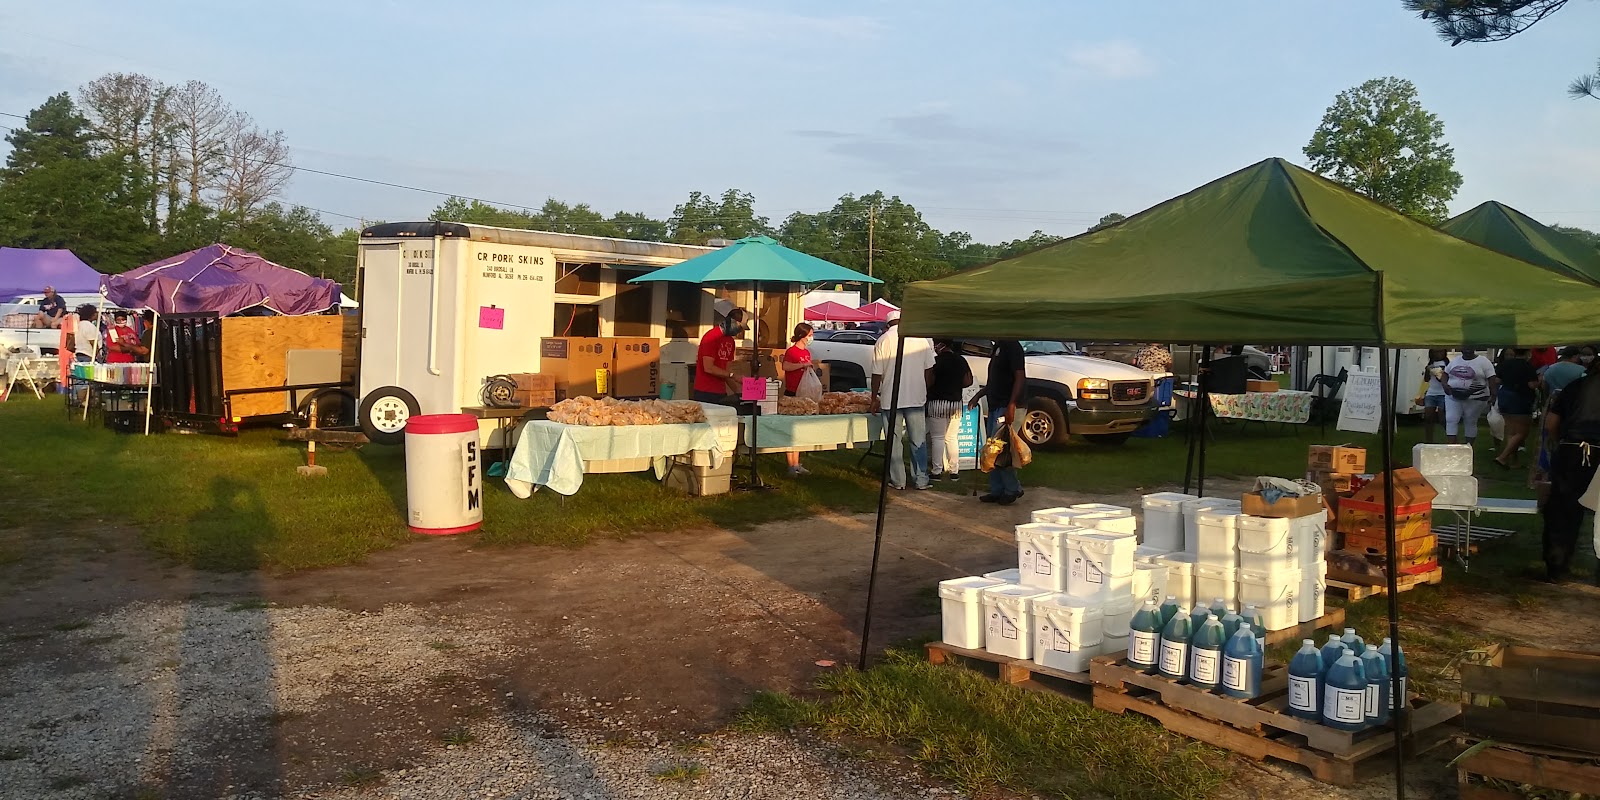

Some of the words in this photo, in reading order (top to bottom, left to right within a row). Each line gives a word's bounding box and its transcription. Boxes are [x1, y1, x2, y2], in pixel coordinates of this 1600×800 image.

[477, 252, 488, 261] CR
[492, 253, 514, 263] PORK
[518, 255, 544, 266] SKINS
[648, 361, 658, 394] Large
[467, 441, 479, 511] SFM
